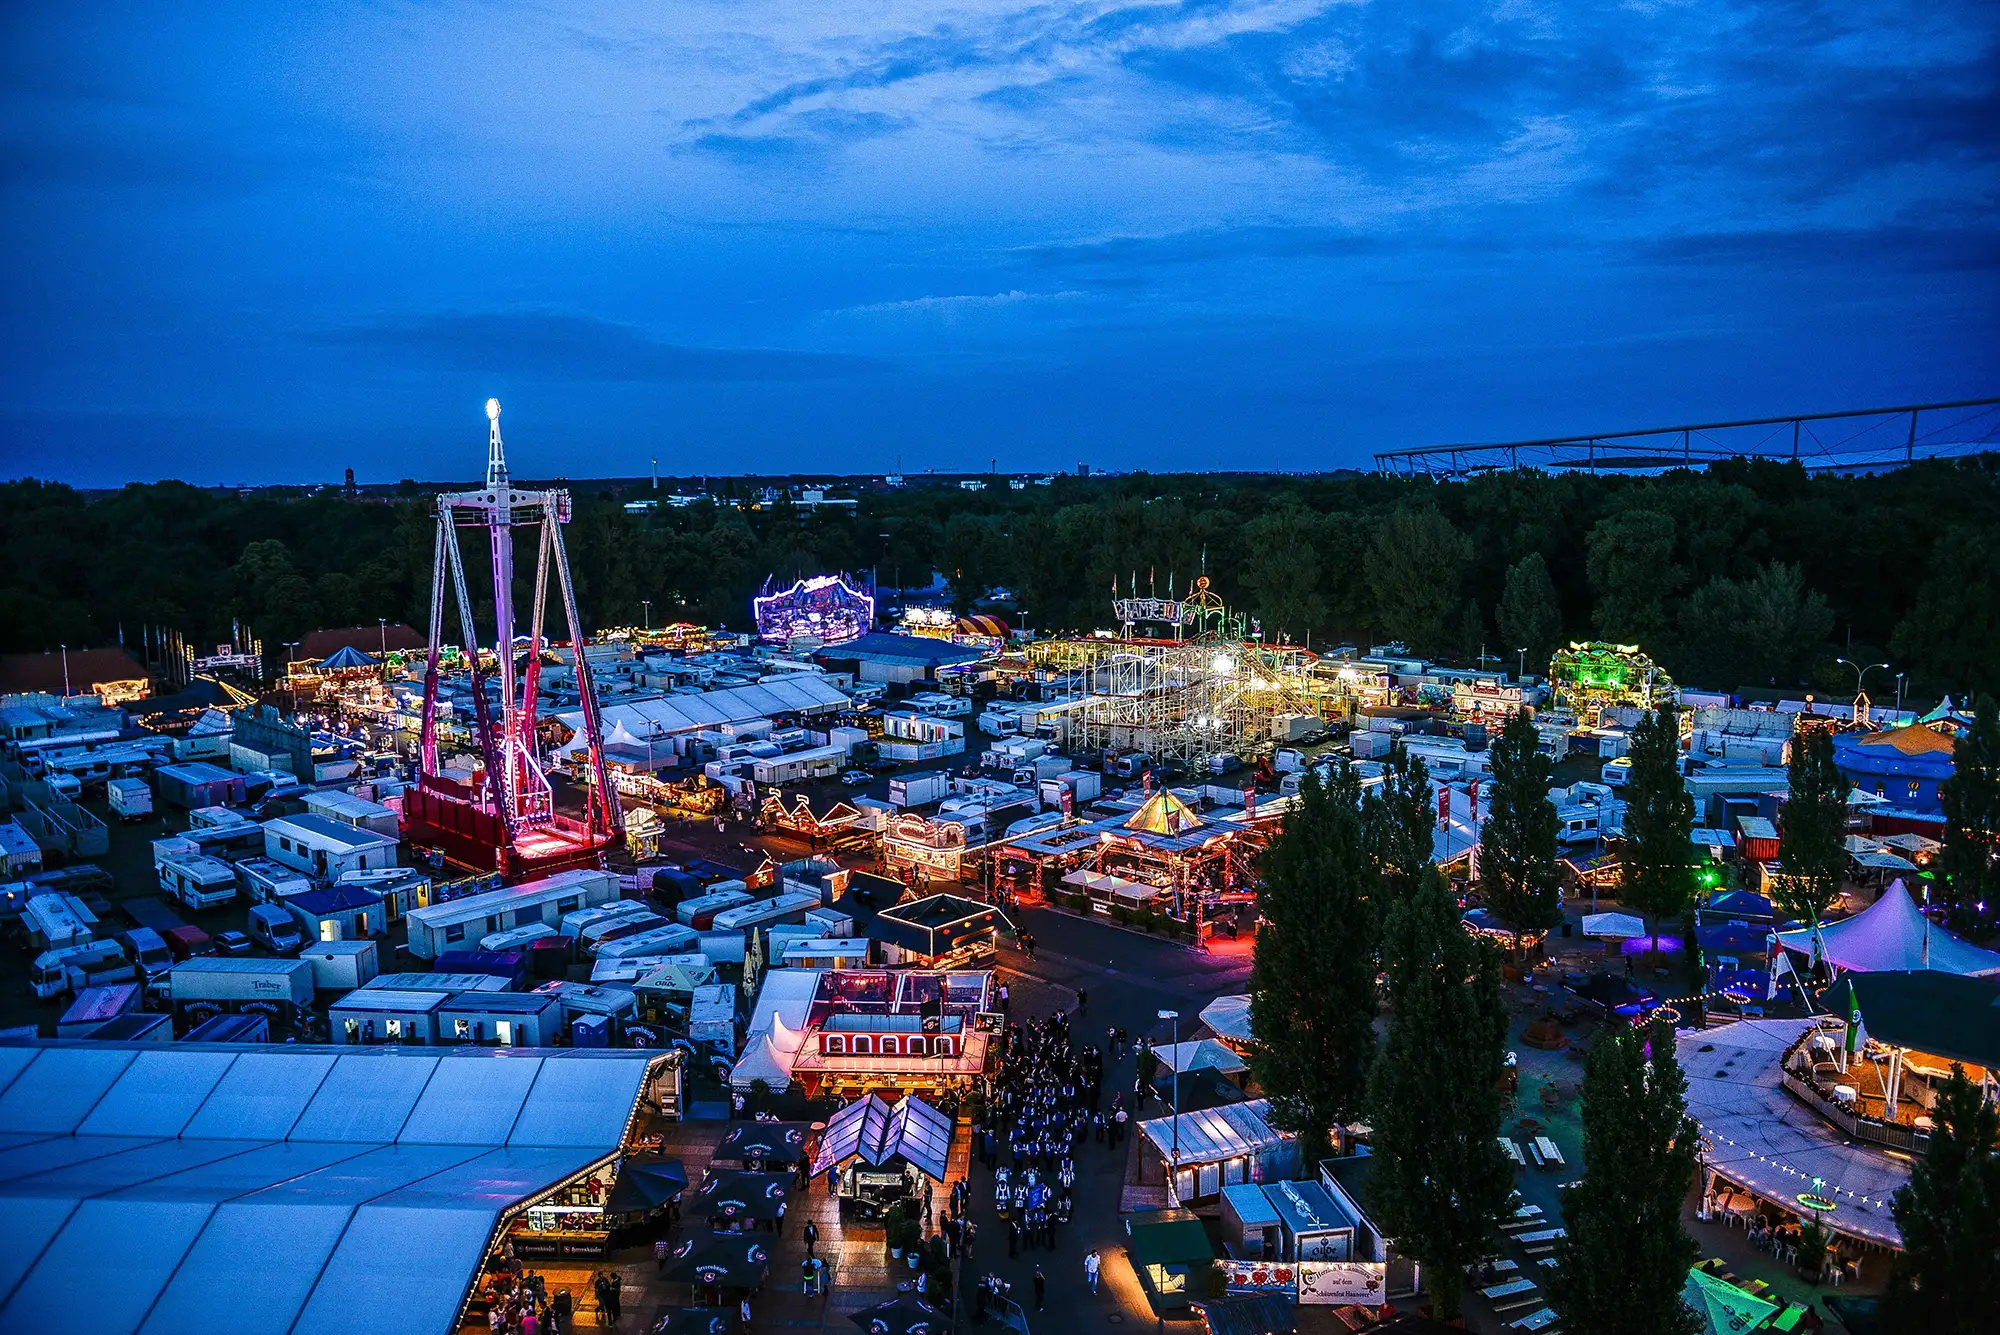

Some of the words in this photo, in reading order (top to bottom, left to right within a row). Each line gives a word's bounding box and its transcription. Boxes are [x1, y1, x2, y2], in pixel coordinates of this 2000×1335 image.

[251, 979, 282, 990] Traber
[655, 980, 677, 988] Gilde
[1312, 1246, 1337, 1256] Gilde
[1346, 1290, 1370, 1298] Hannover
[1728, 1311, 1755, 1332] Gilde
